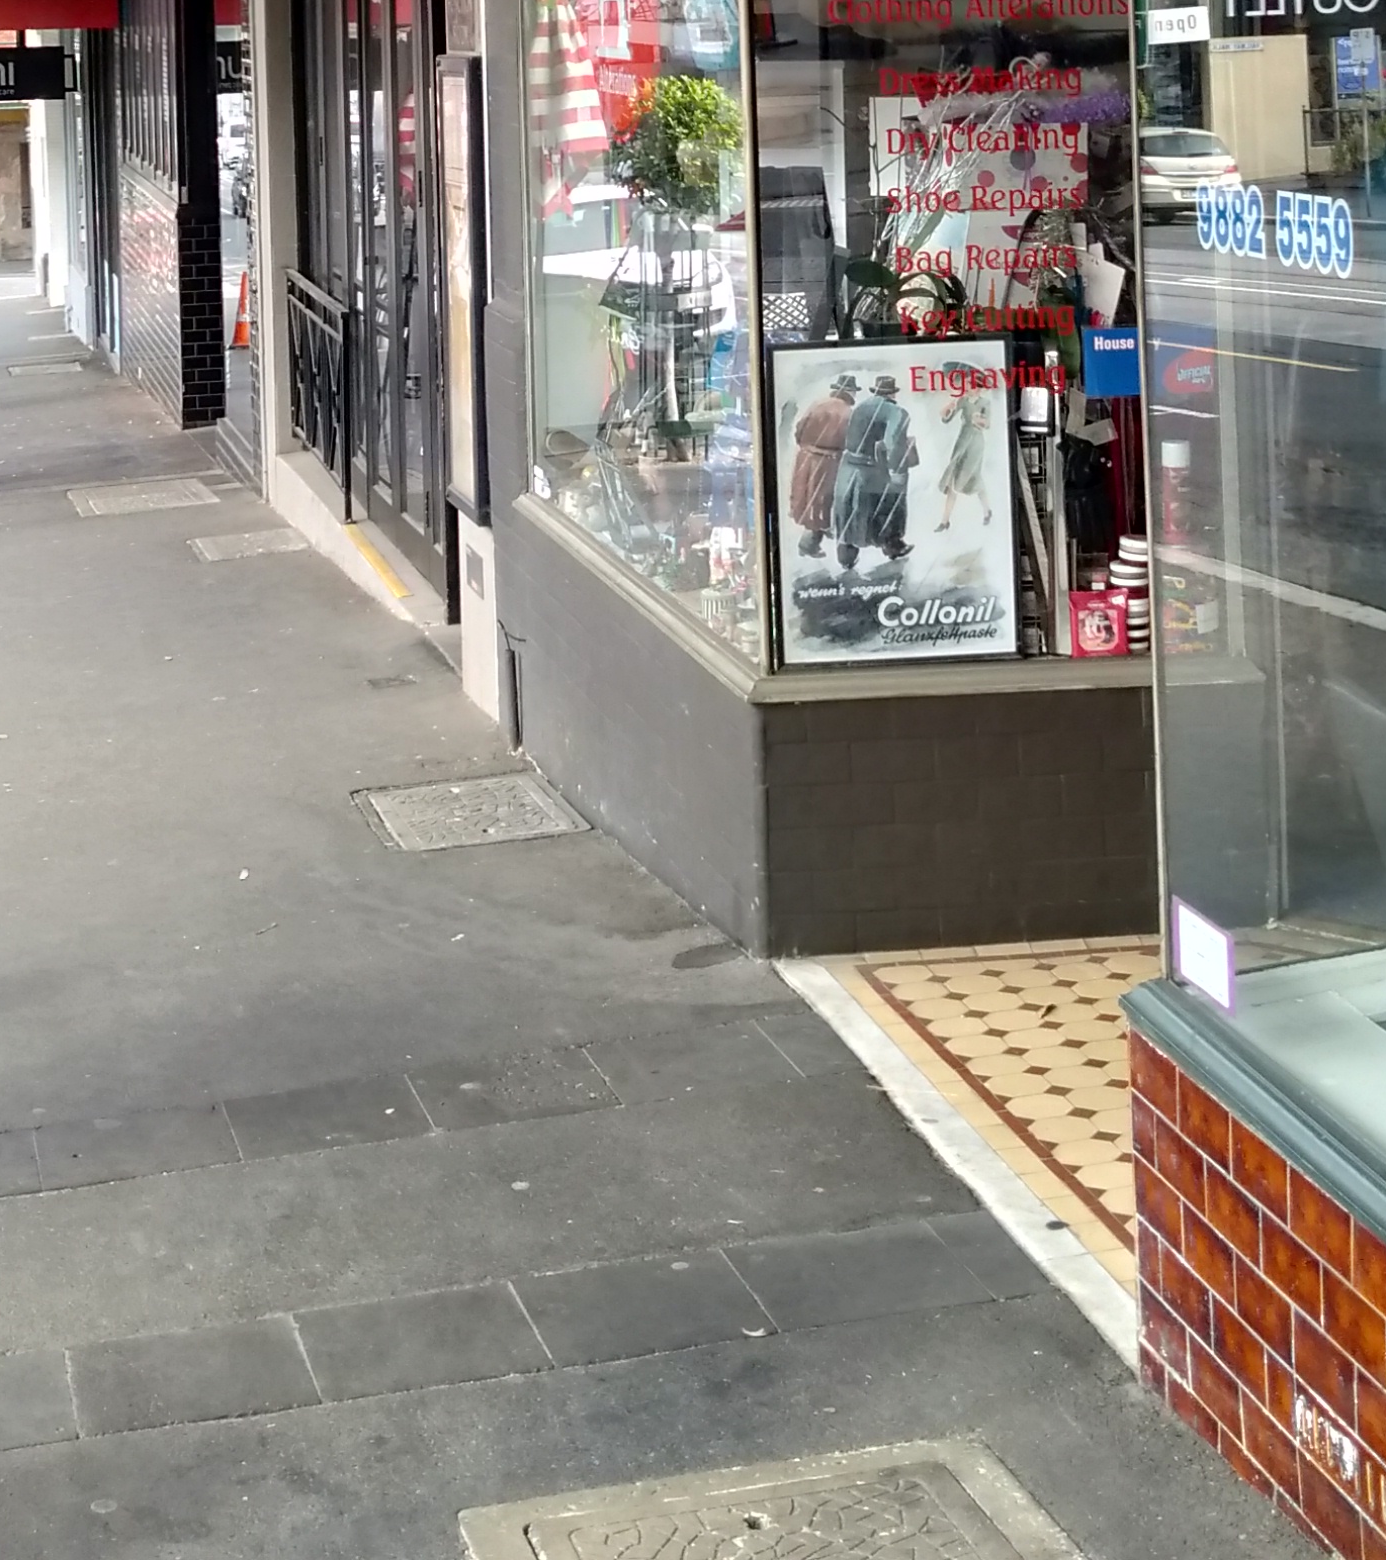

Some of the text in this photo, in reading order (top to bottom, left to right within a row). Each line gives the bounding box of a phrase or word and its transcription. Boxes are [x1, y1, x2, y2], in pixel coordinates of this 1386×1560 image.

[878, 64, 1084, 100] Dress Making
[886, 123, 1080, 161] Dry Cleaning
[886, 181, 1085, 217] Shoe Repairs
[1196, 177, 1354, 279] 9882 5559
[895, 243, 1079, 276] Bag Repairs
[900, 302, 1076, 340] Key Cutting
[1093, 336, 1135, 351] House
[909, 362, 1067, 399] Engraving
[877, 596, 998, 628] Collonil
